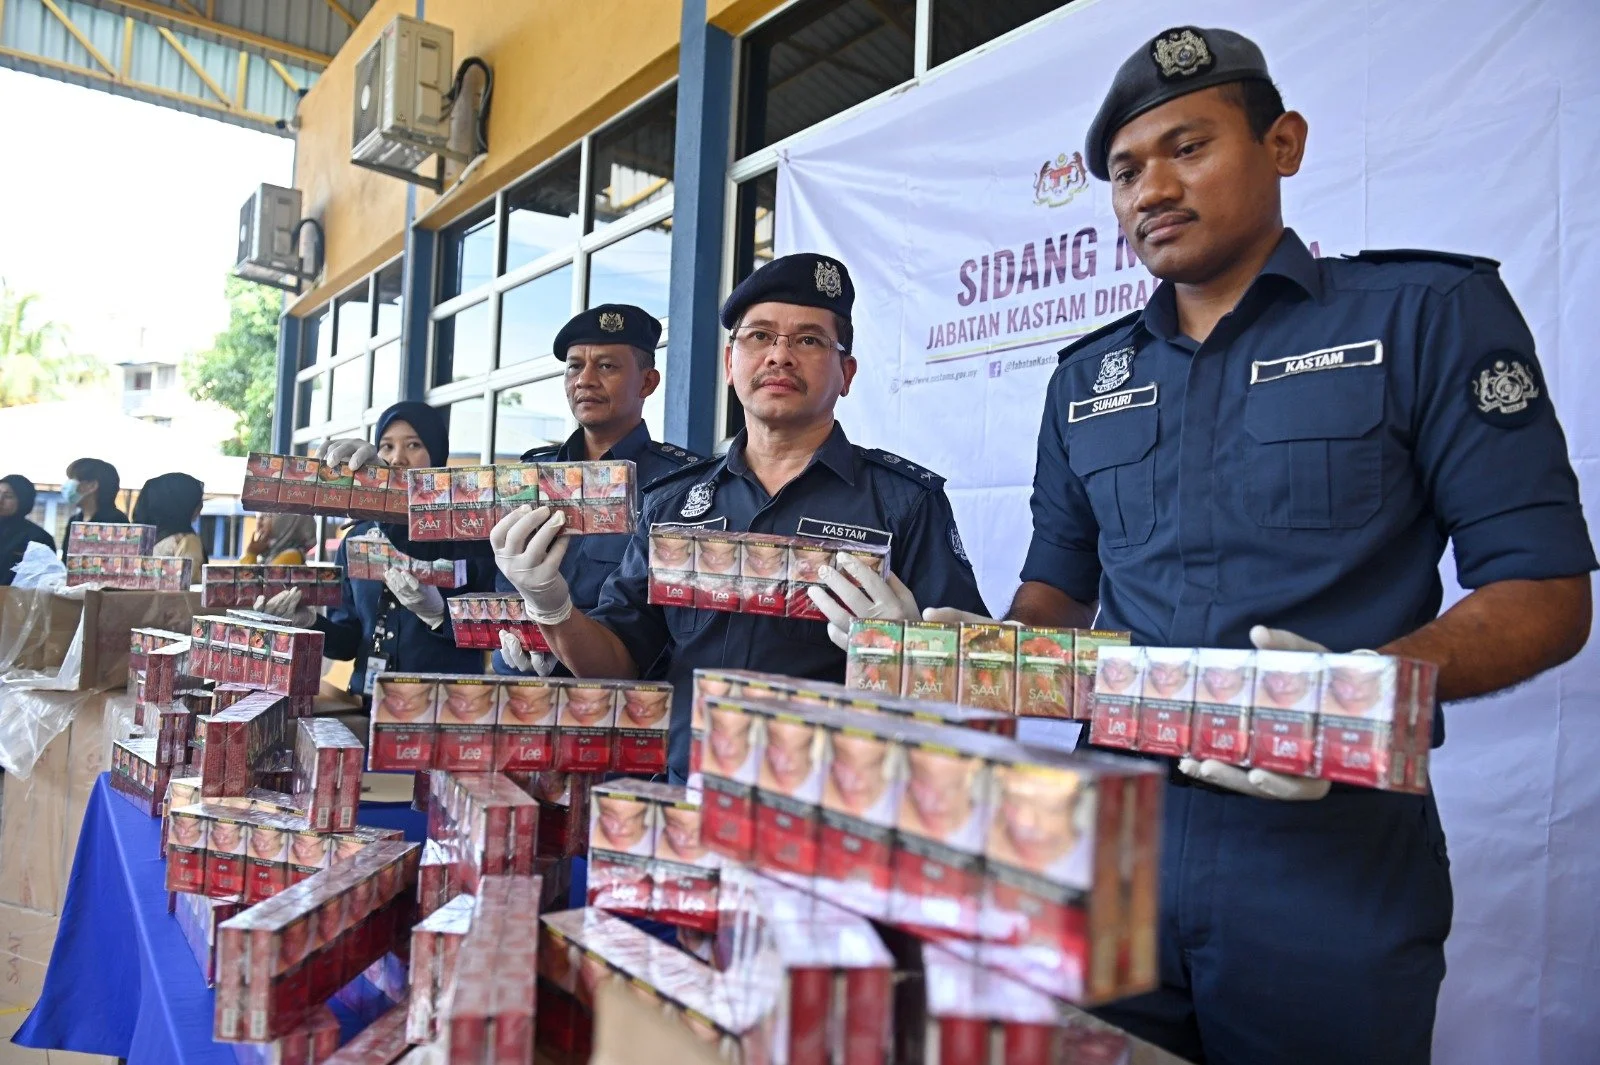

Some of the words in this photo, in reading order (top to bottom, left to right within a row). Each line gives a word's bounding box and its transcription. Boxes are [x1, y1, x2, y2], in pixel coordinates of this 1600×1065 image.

[957, 227, 1098, 307] SIDANG
[926, 311, 1000, 350] JABATAN
[1006, 293, 1086, 334] KASTAM
[1094, 278, 1163, 317] DIRA
[1285, 351, 1345, 373] KASTAM
[1092, 393, 1132, 412] SUHAIRI
[418, 519, 441, 530] SAAT
[461, 518, 484, 528] SAAT
[593, 513, 617, 524] SAAT
[822, 525, 867, 541] KASTAM
[666, 585, 684, 598] Lee
[712, 590, 730, 603] Lee
[758, 594, 776, 607] Lee
[858, 679, 888, 691] SAAT
[914, 680, 944, 694] SAAT
[970, 684, 1001, 697] SAAT
[1028, 688, 1058, 702] SAAT
[396, 744, 420, 760] Lee
[459, 744, 482, 760] Lee
[519, 745, 542, 761] Lee
[678, 890, 706, 913] Lee
[6, 931, 22, 986] SAAT
